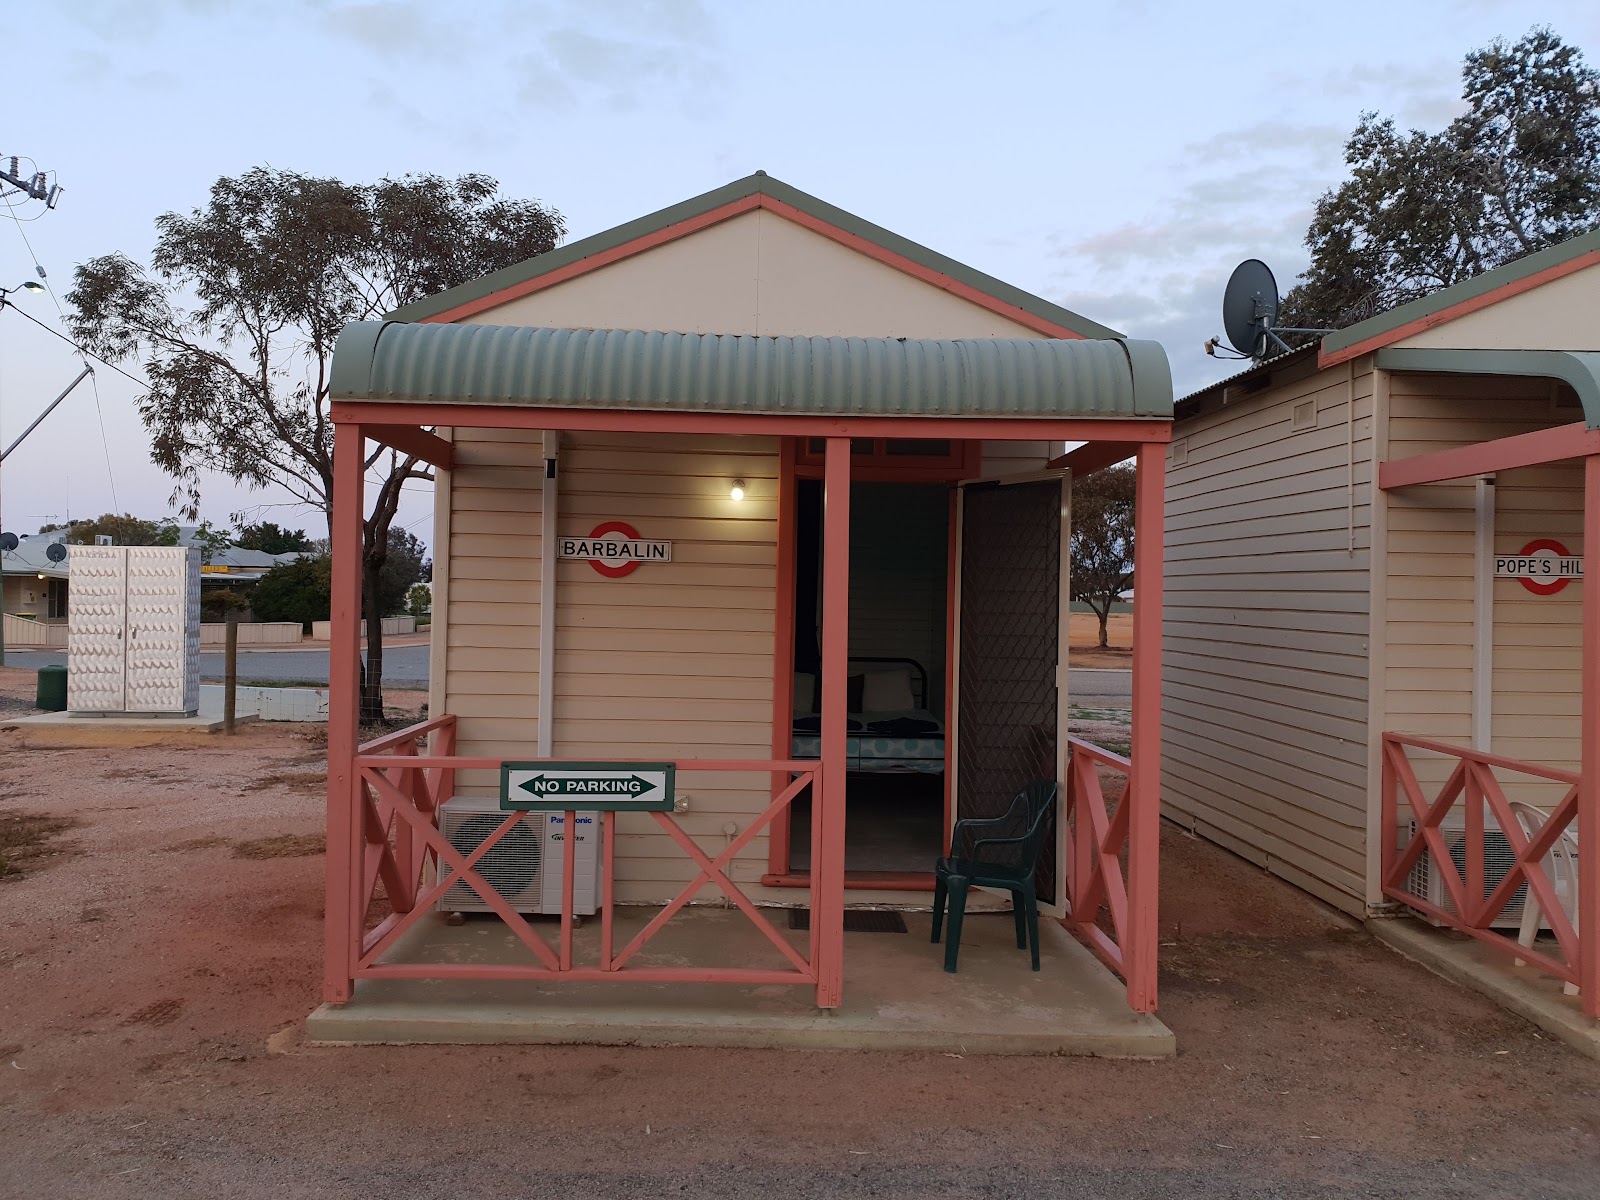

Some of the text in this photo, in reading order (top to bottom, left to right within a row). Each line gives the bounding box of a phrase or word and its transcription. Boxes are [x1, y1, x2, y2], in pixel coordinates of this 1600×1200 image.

[563, 541, 665, 559] BARBALIN
[1496, 559, 1584, 574] POPE'S HIL
[534, 780, 641, 792] NO PARKING
[550, 816, 593, 824] Panonic
